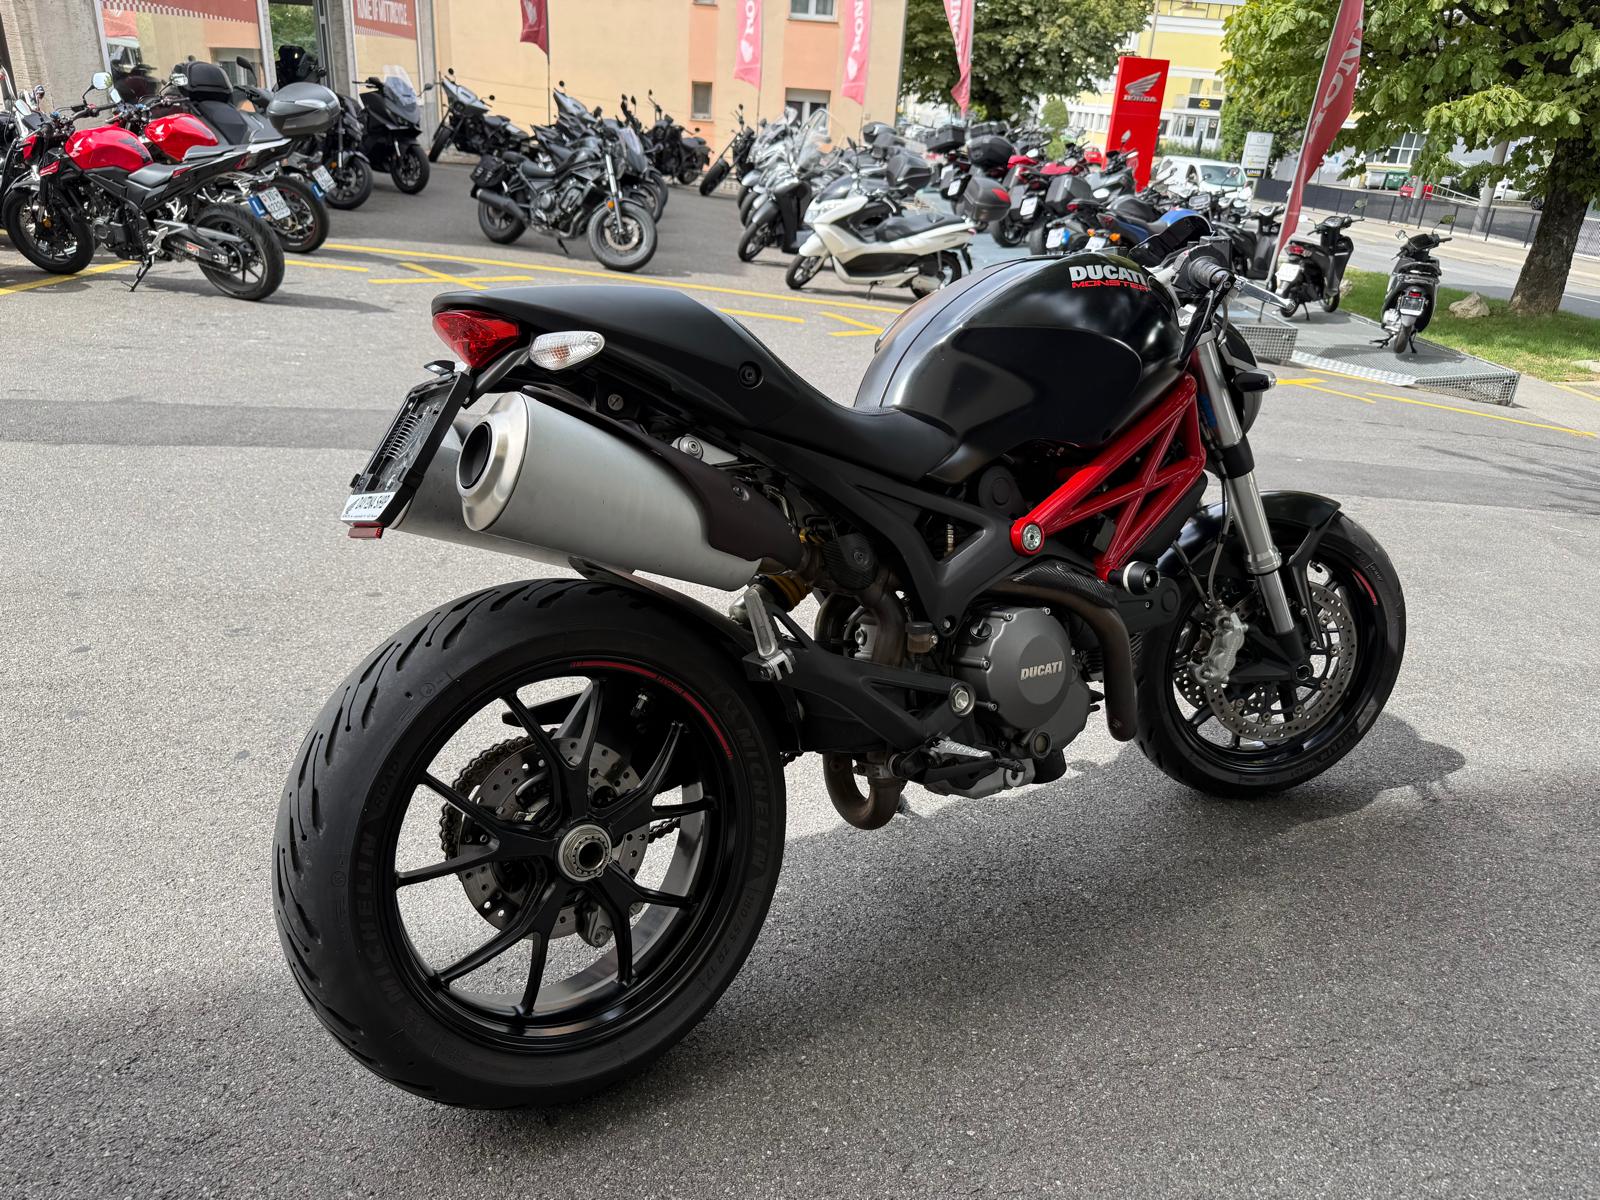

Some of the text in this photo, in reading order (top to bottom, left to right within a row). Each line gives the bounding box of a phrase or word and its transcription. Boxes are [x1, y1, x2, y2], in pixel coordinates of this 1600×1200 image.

[1122, 95, 1157, 103] HONDA
[252, 200, 265, 214] L
[1069, 265, 1146, 284] DUCATI
[1020, 660, 1063, 680] DUCATI
[735, 728, 769, 872] MICHELIN
[357, 831, 405, 1002] MICHELIN
